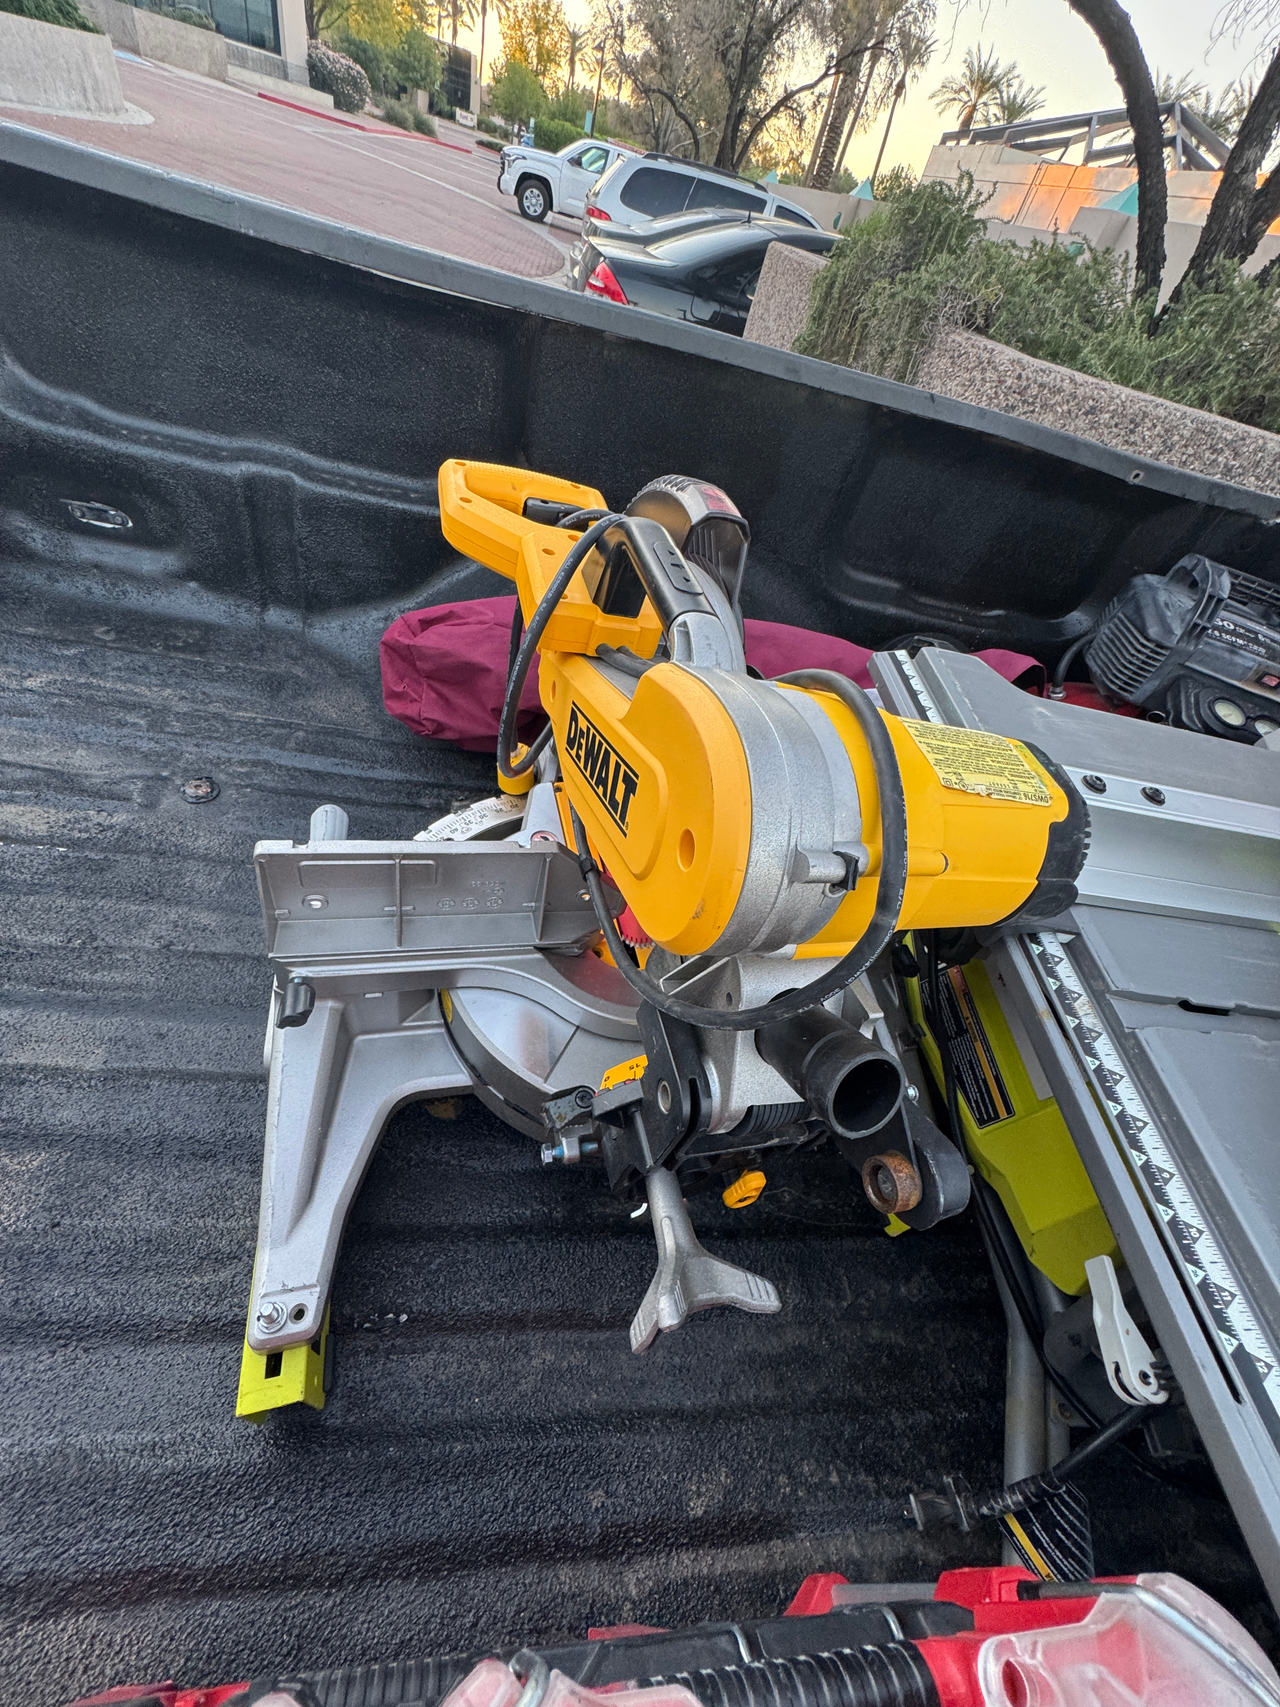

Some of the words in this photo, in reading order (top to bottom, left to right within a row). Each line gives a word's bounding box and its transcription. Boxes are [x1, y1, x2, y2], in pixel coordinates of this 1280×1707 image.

[566, 706, 638, 827] DEWALT
[1188, 1226, 1200, 1238] 10
[1220, 1291, 1232, 1300] 11
[1255, 1360, 1268, 1374] 12
